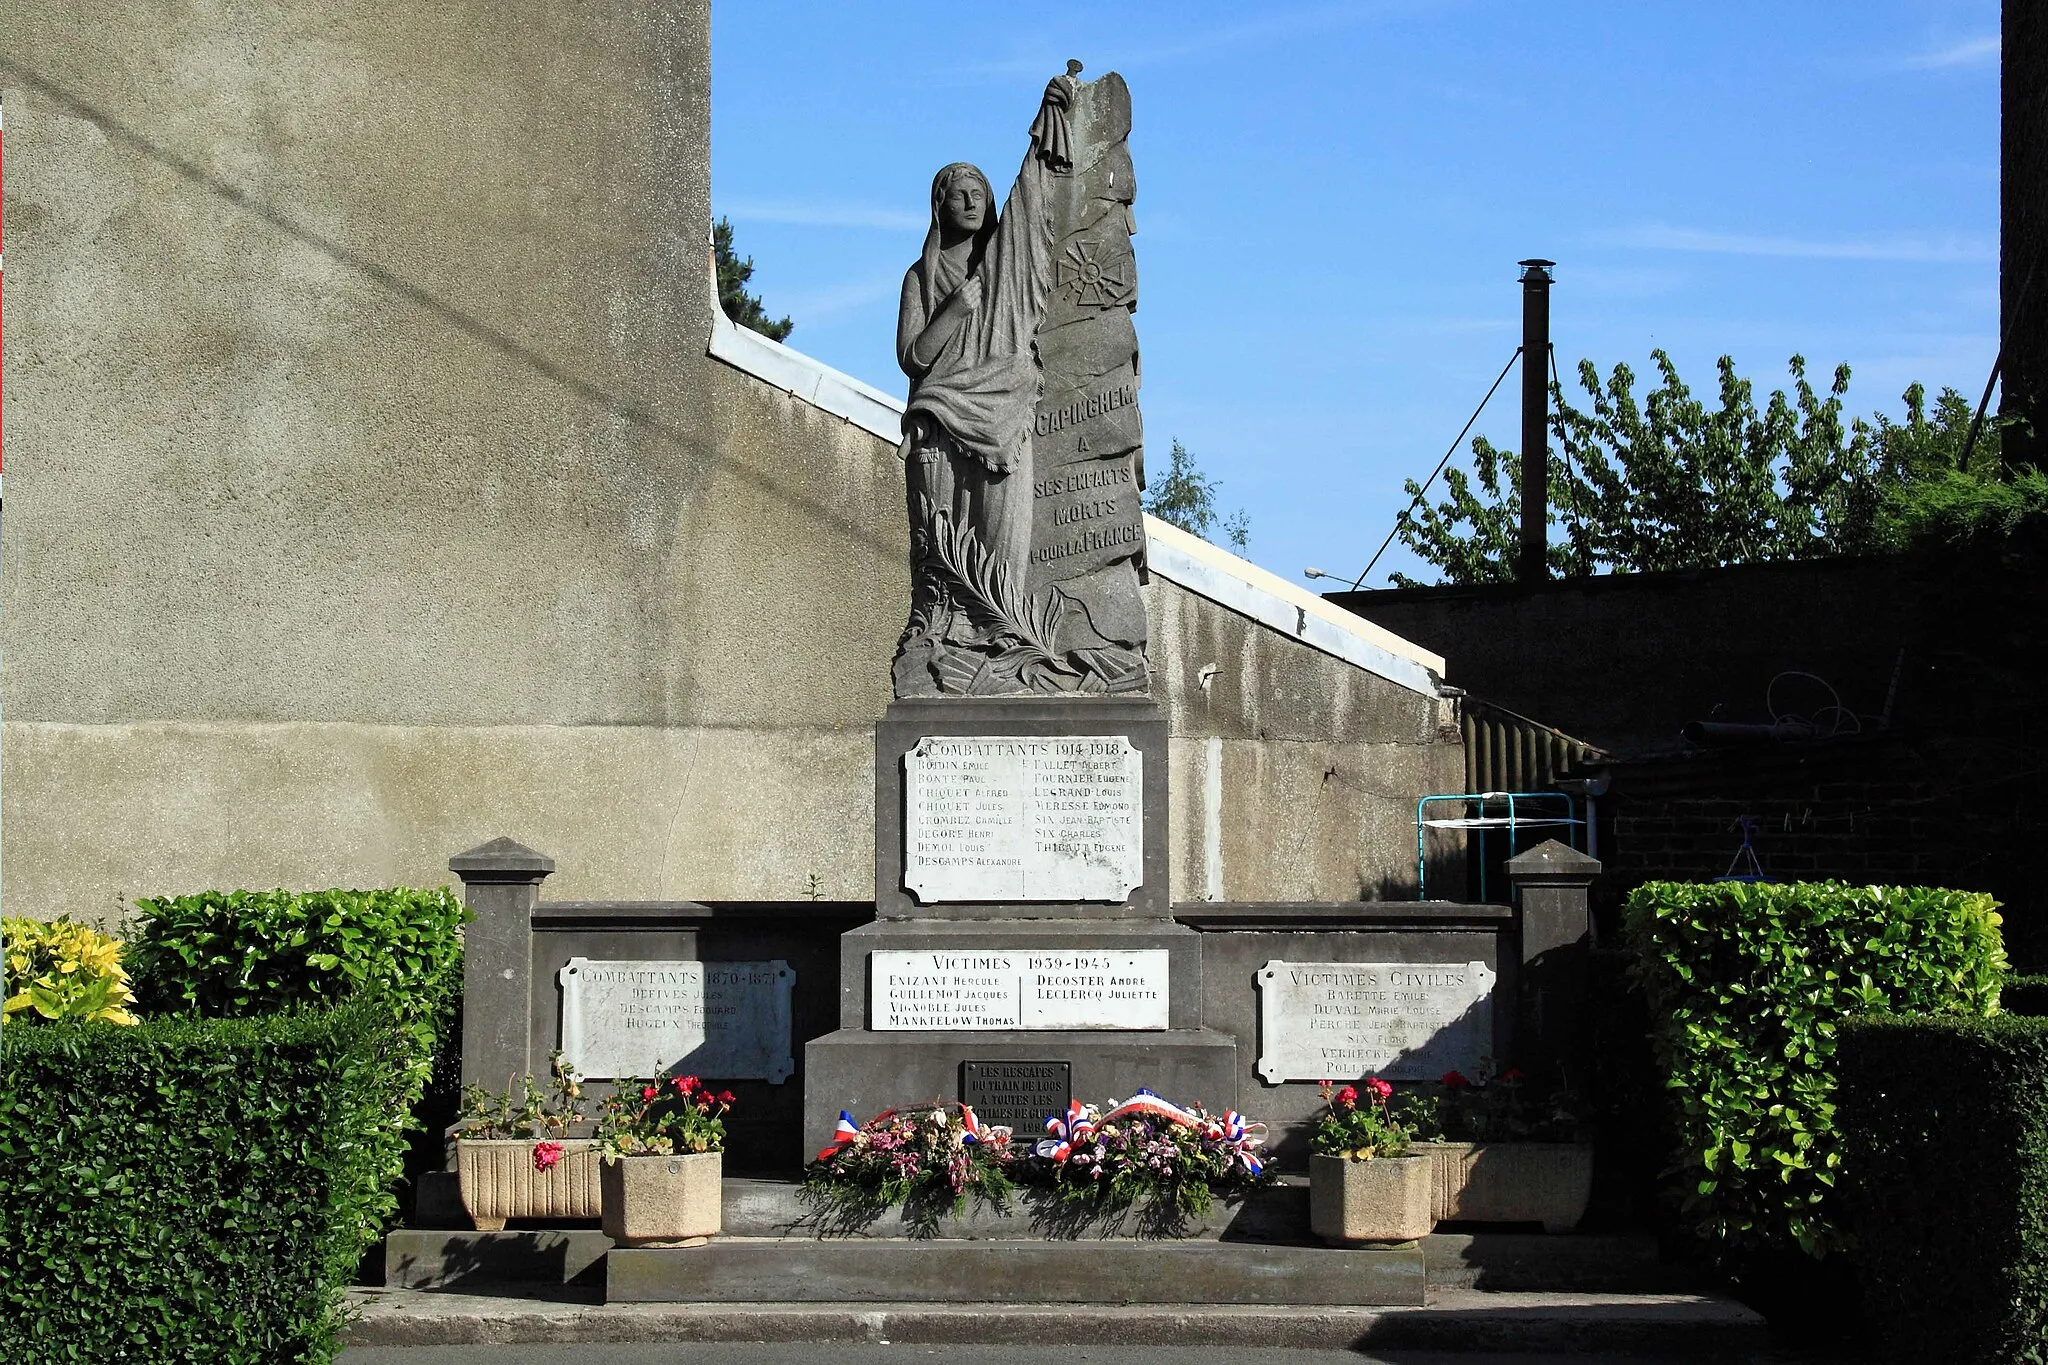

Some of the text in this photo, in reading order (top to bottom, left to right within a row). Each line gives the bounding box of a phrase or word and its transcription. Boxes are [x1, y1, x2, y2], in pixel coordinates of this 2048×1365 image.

[1035, 385, 1135, 437] CAPINGHEM
[1078, 436, 1090, 453] A
[1034, 467, 1130, 499] SES ENFANTS
[1054, 499, 1116, 526] MORTS
[1030, 523, 1141, 565] POUR LA FRANCE
[928, 743, 1119, 756] COMBATTANTS 1914-1918
[963, 762, 988, 770] EMILE
[1034, 760, 1116, 770] FALLET ALBERT
[918, 774, 985, 783] BONTE PAUL
[1034, 774, 1129, 783] FOURNIER EUGENE
[918, 788, 1008, 798] CHIQUET ALFRED
[1034, 787, 1122, 797] LEGRAND LOUIS
[918, 802, 1003, 812] CHIQUET JULES
[1093, 801, 1129, 811] EDMOND
[918, 816, 1013, 825] CROMBEZ CAMILLE
[1035, 815, 1054, 824] SIX
[918, 829, 994, 838] DEGORE HENRI
[1035, 828, 1101, 838] SIX CHARLES
[918, 843, 985, 852] DEMOL LOUIS
[1035, 842, 1126, 852] THIBAUT EUGENE
[918, 856, 1022, 866] DESCAMPS ALEXANDRE
[933, 955, 1110, 970] VICTIMES 1939-1945
[582, 968, 775, 985] COMBATTANTS 1870-1871
[889, 975, 1000, 986] ENIZANT HERCULE
[1037, 974, 1145, 986] DECOSTER ANDRE
[1290, 970, 1464, 986] VICTIMES CIVILES
[632, 988, 723, 1000] DEFIVES JULES
[890, 988, 1008, 1000] GUILLEMOT JACQUES
[1037, 988, 1158, 1001] LECLERCQ JULIETTE
[1328, 989, 1426, 1001] BARETTE EMILE
[620, 1003, 736, 1015] DESCAMPS EDOUARD
[890, 1002, 986, 1012] VIGNOBLE JULES
[1314, 1003, 1361, 1015] DUVAL
[1368, 1005, 1399, 1015] MARIE
[889, 1015, 1015, 1026] MANKTELOW THOMAS
[1310, 1019, 1360, 1029] PERCHE
[1347, 1033, 1408, 1044] SIX FLORE
[980, 1066, 1055, 1078] LES RESCAPES
[1326, 1061, 1377, 1073] POLLET
[972, 1080, 1063, 1092] DU TRAIN DE LOOS
[980, 1095, 1054, 1106] A TOUTES LES
[1014, 1107, 1028, 1119] DE
